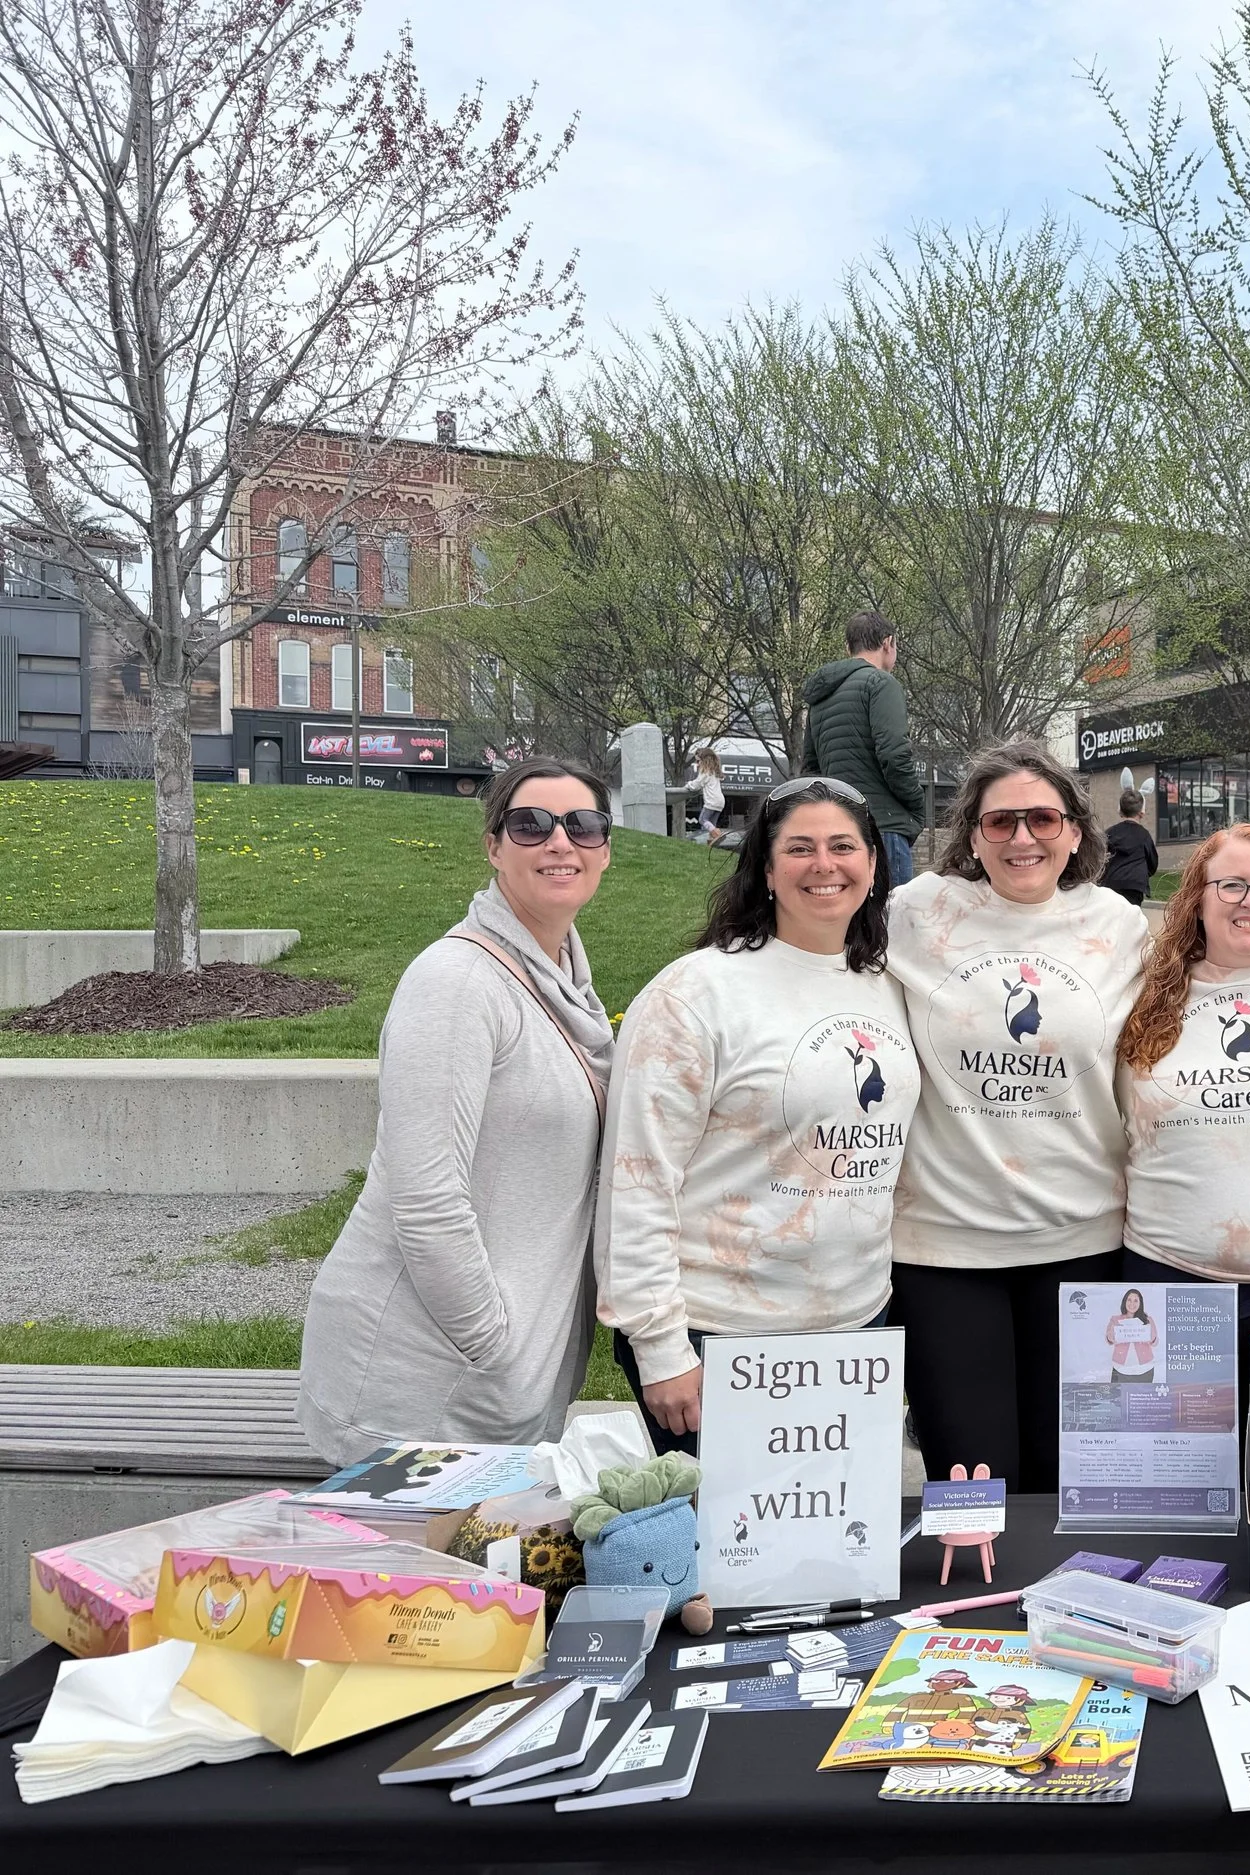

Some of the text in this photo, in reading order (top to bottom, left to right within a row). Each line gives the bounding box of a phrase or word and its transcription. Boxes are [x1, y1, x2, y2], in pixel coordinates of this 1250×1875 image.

[287, 610, 345, 627] element
[1096, 720, 1165, 748] BEAVER ROCK
[306, 774, 334, 785] Eat-in
[365, 776, 386, 788] Play
[959, 956, 1081, 993] More than therapy
[1180, 991, 1243, 1023] More than
[809, 1019, 907, 1053] More than therapy
[959, 1049, 1068, 1079] MARSHA
[981, 1077, 1033, 1102] Care
[980, 1106, 1018, 1119] Health
[1152, 1117, 1200, 1130] Women's
[1204, 1114, 1245, 1126] Health
[813, 1123, 904, 1151] MARSHA
[830, 1154, 879, 1179] Care
[770, 1182, 865, 1199] Women's Health
[1168, 1295, 1196, 1305] Feeling
[1168, 1305, 1221, 1314] overwhelmed,
[1168, 1315, 1200, 1323] anxious,
[1211, 1314, 1232, 1322] stuck
[1168, 1324, 1220, 1333] in your story?
[1168, 1343, 1214, 1352] Let's begin
[1168, 1353, 1221, 1363] your healing
[1168, 1363, 1195, 1371] today!
[729, 1352, 890, 1400] Sign up
[767, 1414, 850, 1454] and
[750, 1481, 848, 1521] win!
[943, 1491, 987, 1500] Victoria Gray
[719, 1547, 760, 1558] MARSHA
[727, 1558, 748, 1567] Care
[422, 1606, 456, 1621] Donuts
[924, 1635, 1005, 1654] FUN
[918, 1650, 1038, 1666] FIRE SAFE
[1087, 1705, 1132, 1714] Book
